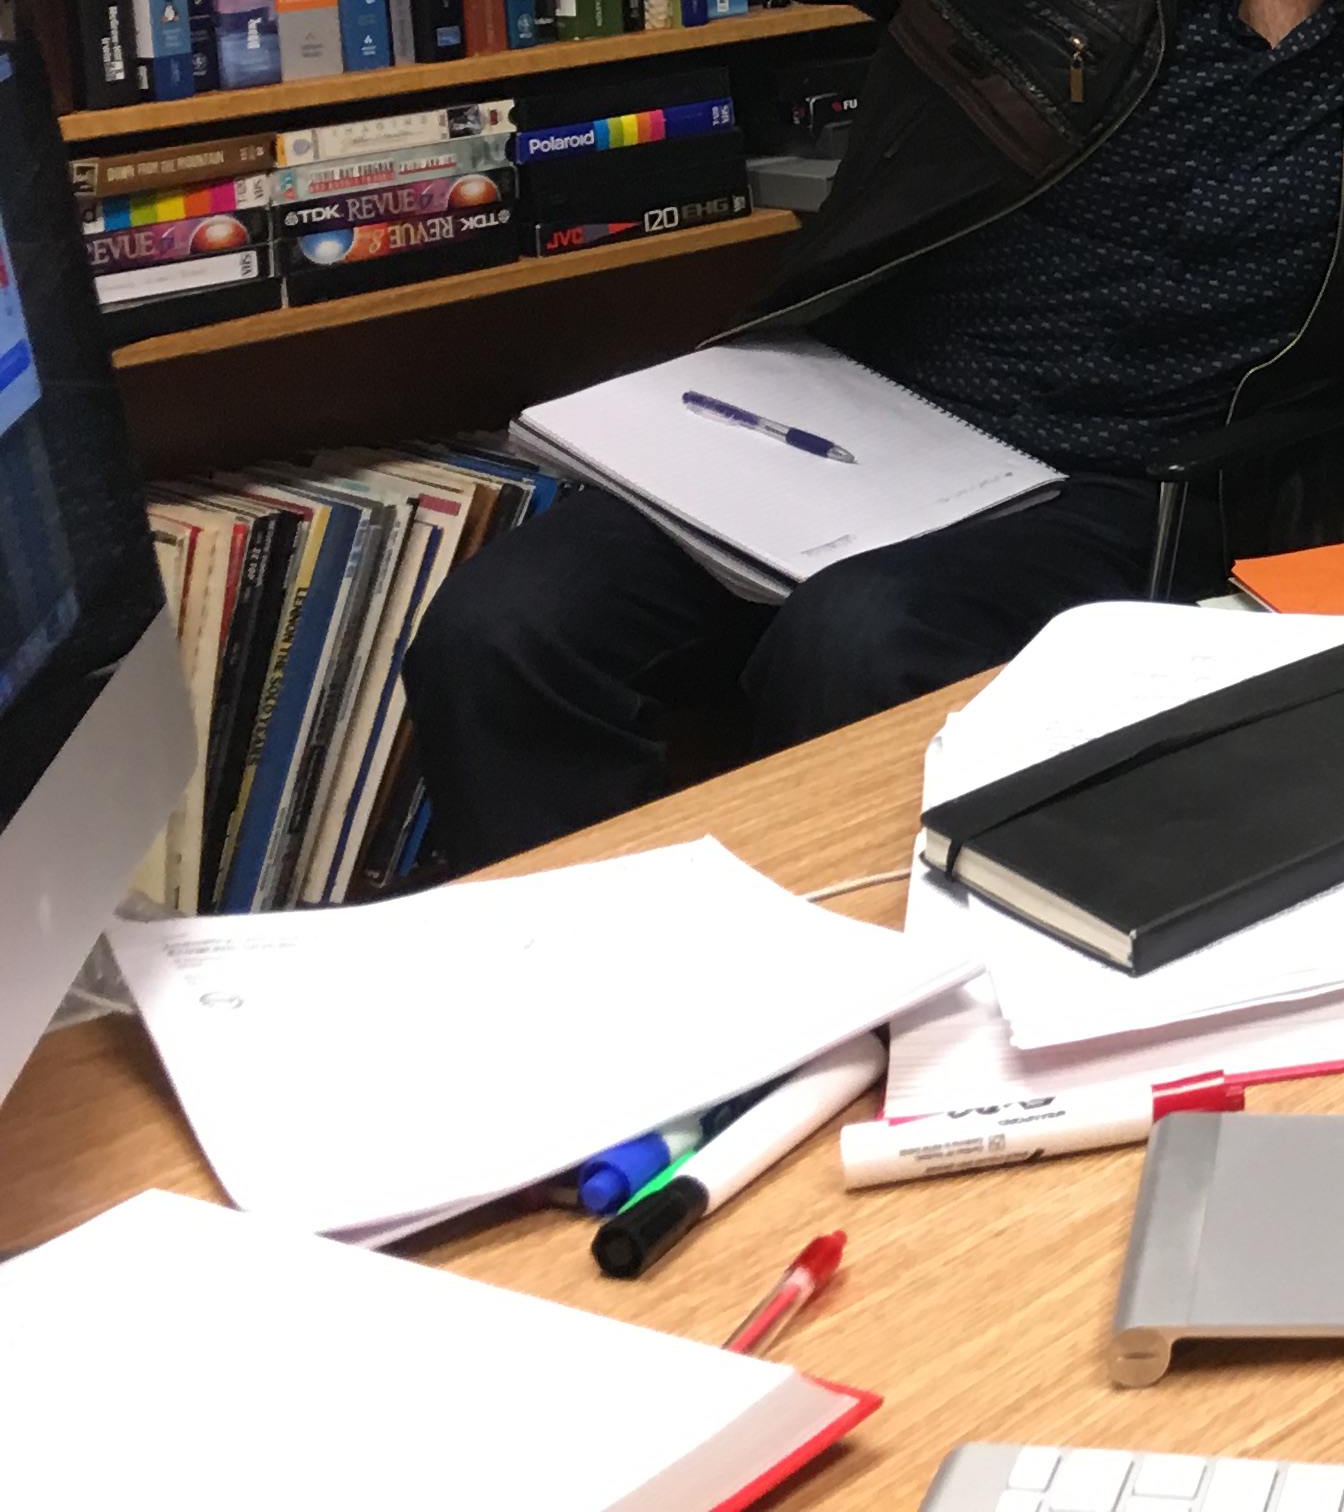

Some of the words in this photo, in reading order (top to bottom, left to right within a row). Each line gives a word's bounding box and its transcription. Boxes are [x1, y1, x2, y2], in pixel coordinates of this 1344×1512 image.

[529, 129, 595, 155] Polaroid
[300, 204, 341, 223] TDK
[347, 188, 417, 222] REVUE
[460, 215, 499, 230] TDK
[389, 215, 454, 249] REVUE
[547, 226, 584, 249] JVC
[644, 207, 679, 232] 120
